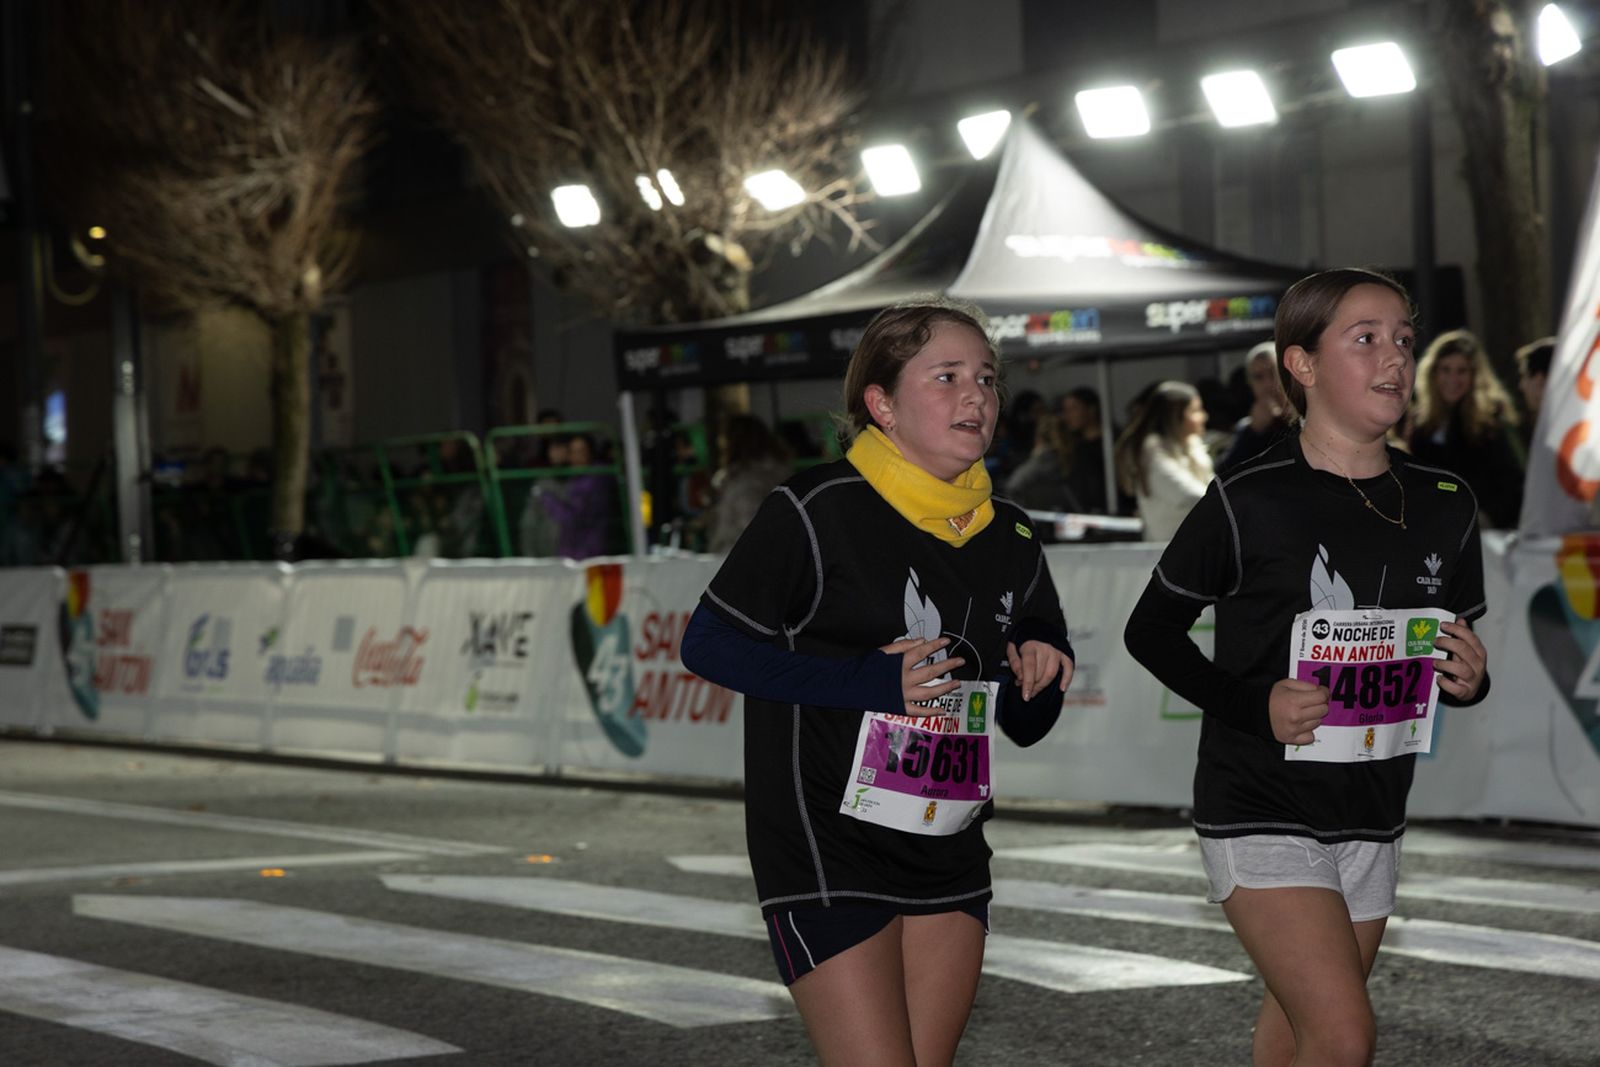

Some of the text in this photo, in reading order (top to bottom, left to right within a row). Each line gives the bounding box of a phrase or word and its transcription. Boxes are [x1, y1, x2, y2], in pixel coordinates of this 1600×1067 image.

[1312, 623, 1329, 635] 43
[1332, 625, 1396, 642] NOCHE DE
[1311, 644, 1345, 662] SAN
[1347, 640, 1396, 662] ANTÓN
[1311, 660, 1423, 710] 14852
[1359, 711, 1384, 725] Gloria
[886, 731, 979, 784] 15631
[920, 785, 948, 797] Aurora
